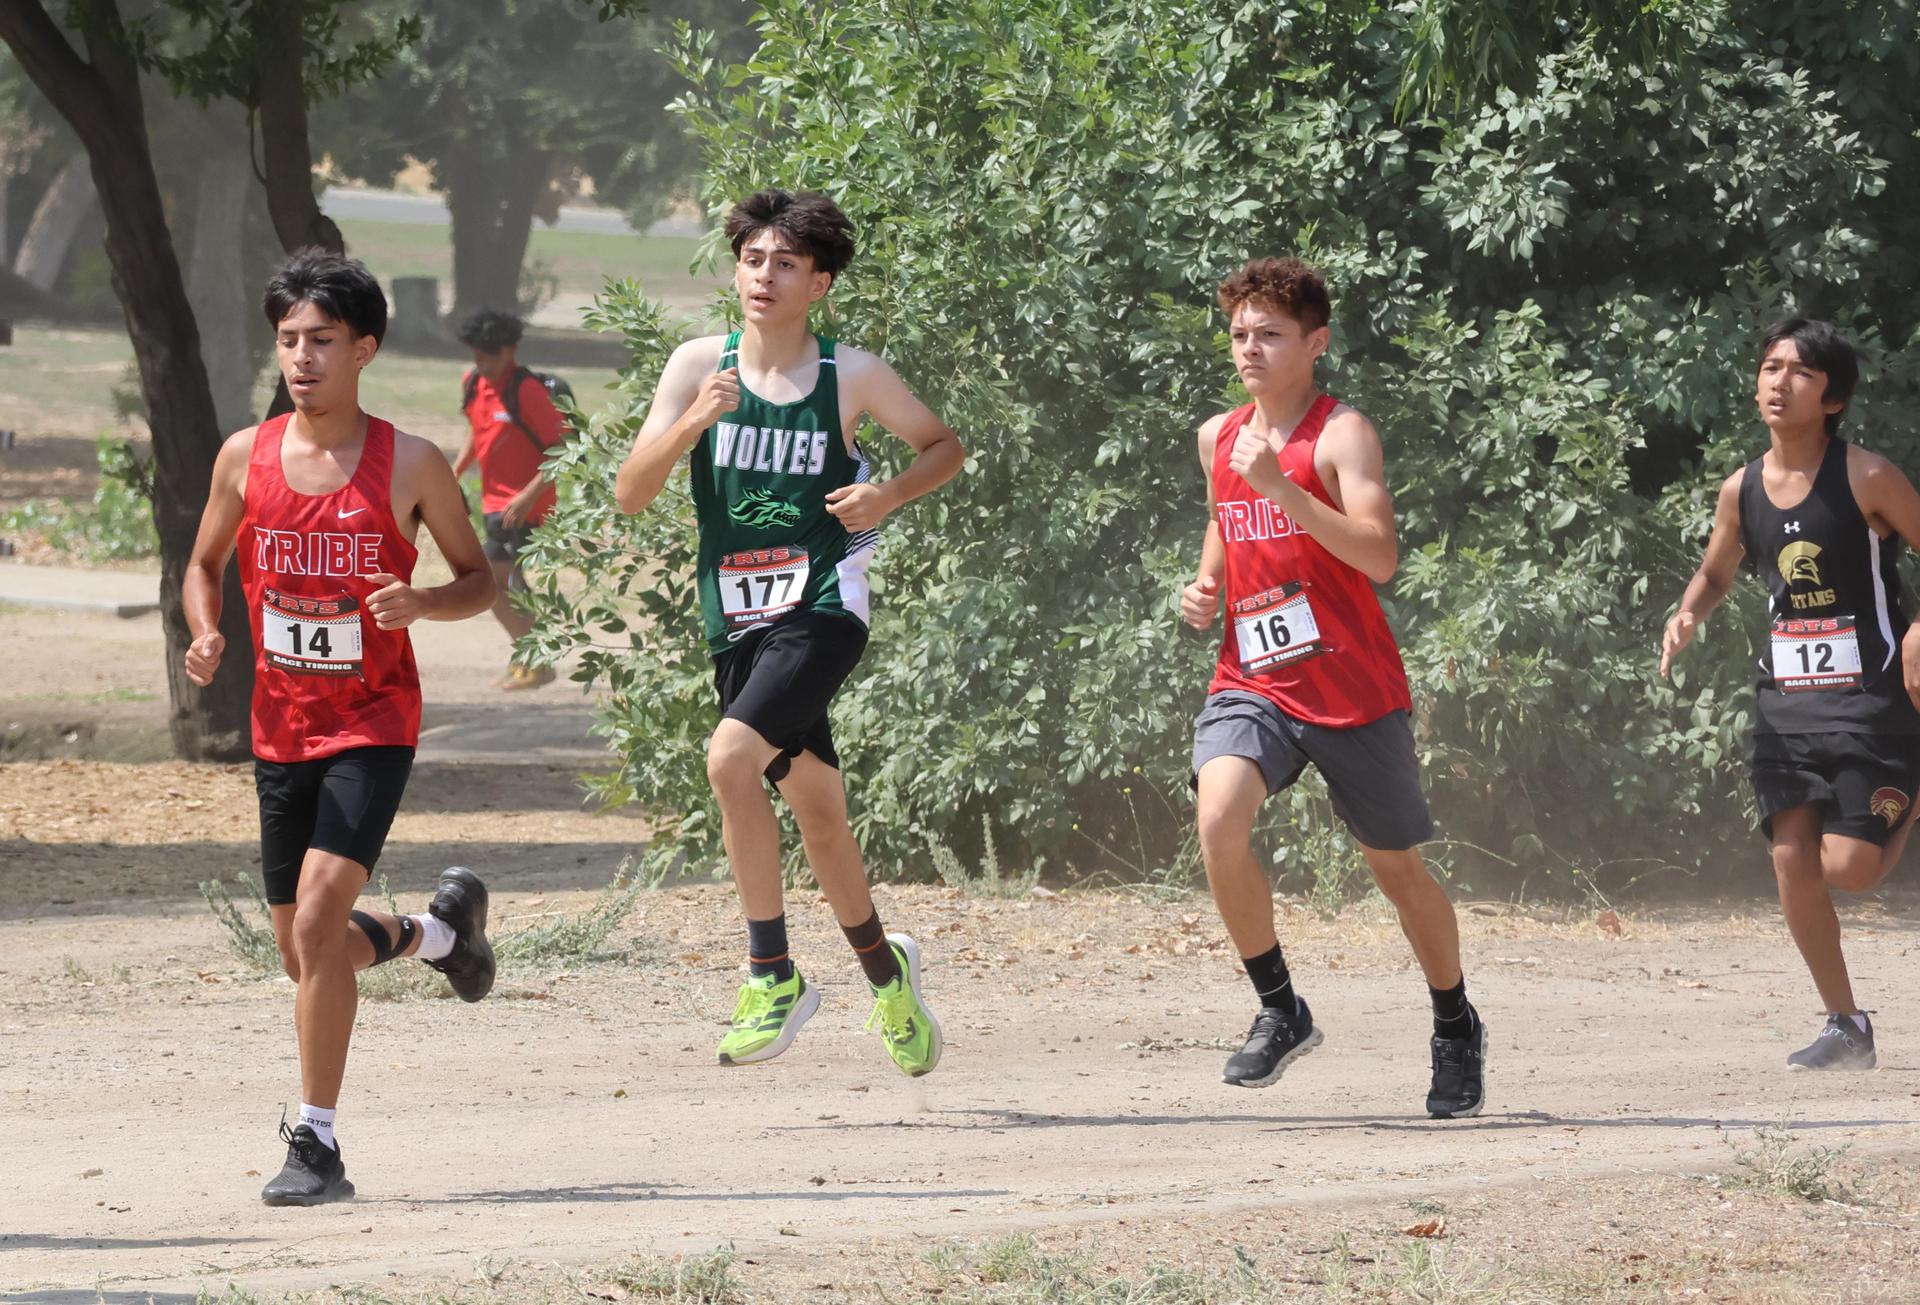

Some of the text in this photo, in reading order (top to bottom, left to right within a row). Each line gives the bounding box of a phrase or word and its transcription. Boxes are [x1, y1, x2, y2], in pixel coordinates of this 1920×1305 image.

[714, 421, 828, 476] WOLVES
[254, 526, 384, 577] TRIBE
[733, 548, 790, 566] RTS
[735, 572, 795, 609] 177
[1241, 587, 1285, 611] RTS
[279, 595, 340, 614] RTS
[734, 613, 762, 622] RACE
[1787, 619, 1838, 632] RTS
[287, 623, 332, 658] 14
[1253, 614, 1291, 652] 16
[273, 655, 353, 671] RACE TIMING
[1249, 644, 1313, 670] RACE TIMING
[1796, 643, 1835, 674] 12
[1784, 676, 1855, 687] RACE TIMING
